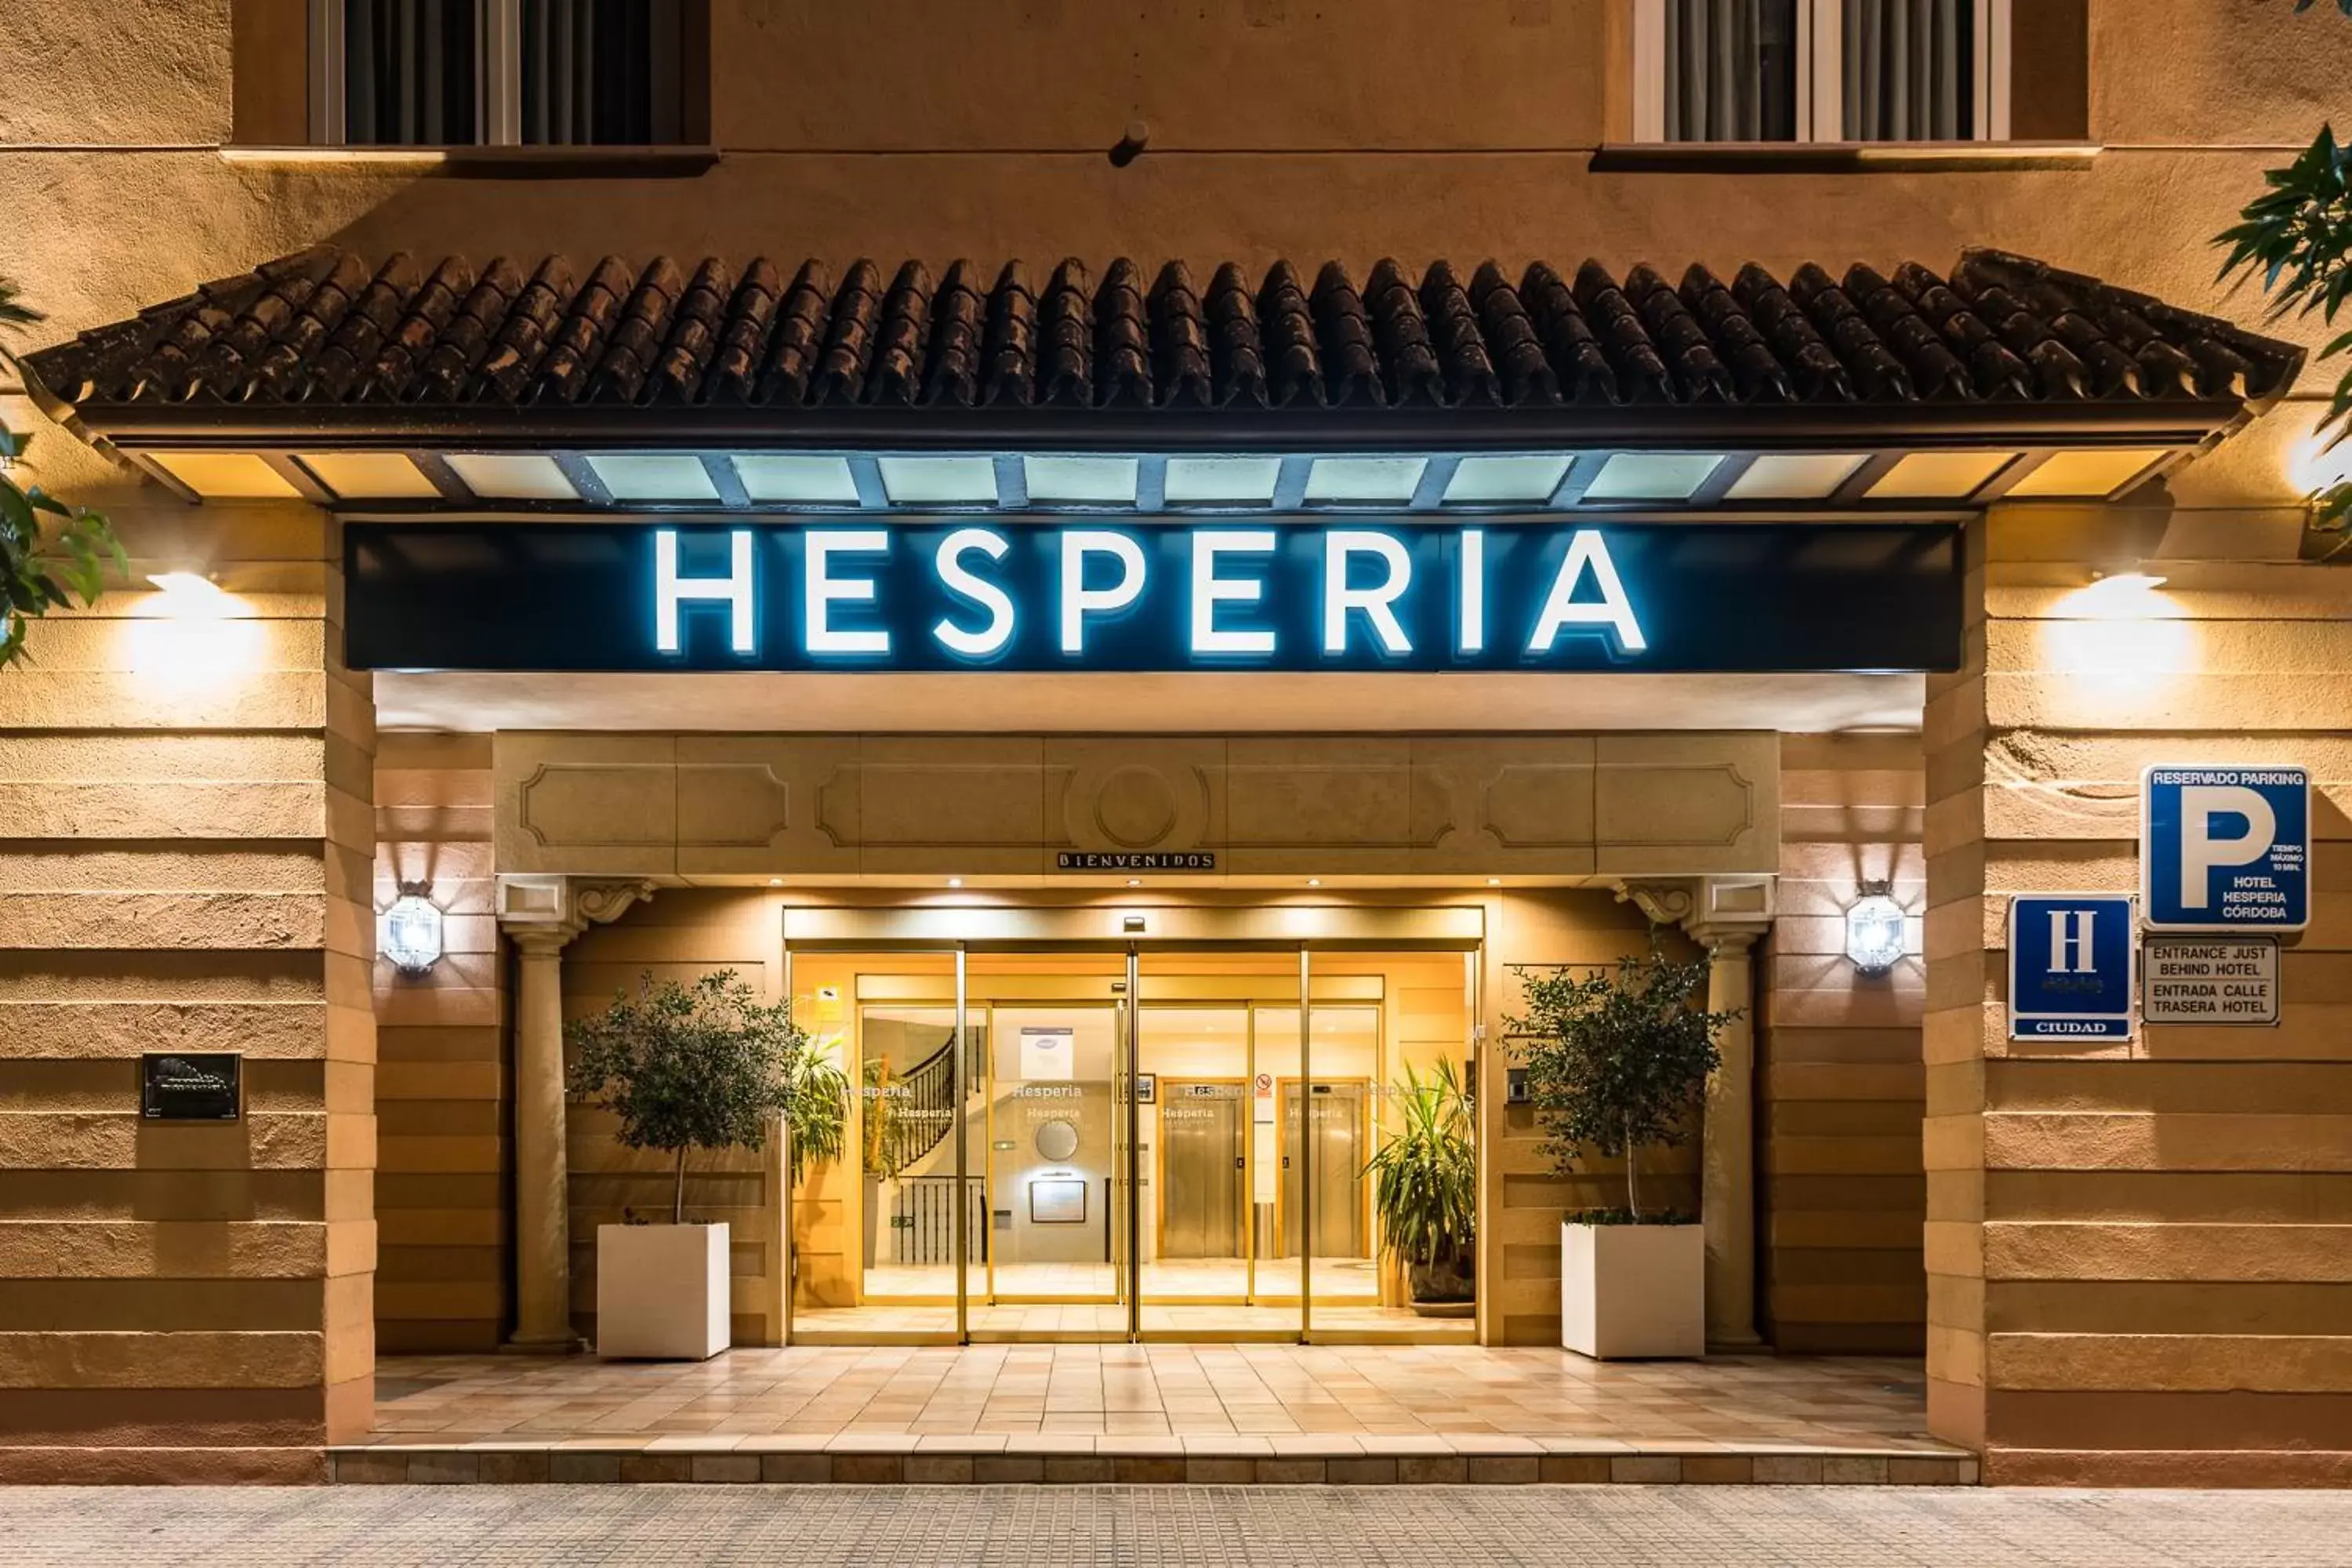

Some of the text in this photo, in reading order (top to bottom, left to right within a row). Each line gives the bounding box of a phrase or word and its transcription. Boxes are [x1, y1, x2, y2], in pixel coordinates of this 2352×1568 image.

[655, 529, 1646, 656] HESPERIA
[2154, 772, 2303, 784] RESERVADO PARKING
[2181, 786, 2276, 909] P
[1059, 854, 1213, 866] BIENVENIDOS
[2234, 877, 2276, 887] HOTEL
[2223, 892, 2287, 903] HESPERIA
[2223, 906, 2287, 918] CÓRDOBA
[2046, 910, 2098, 972] H
[2154, 947, 2267, 959] ENTRANCE JUST
[2160, 964, 2260, 975] BEHIND HOTEL
[2154, 985, 2267, 996] ENTRADA CALLE
[2154, 1001, 2267, 1012] TRASERA HOTEL
[2036, 1022, 2107, 1033] CIUDAD
[841, 1085, 910, 1098] Hsperia
[1014, 1085, 1082, 1098] Hesperia
